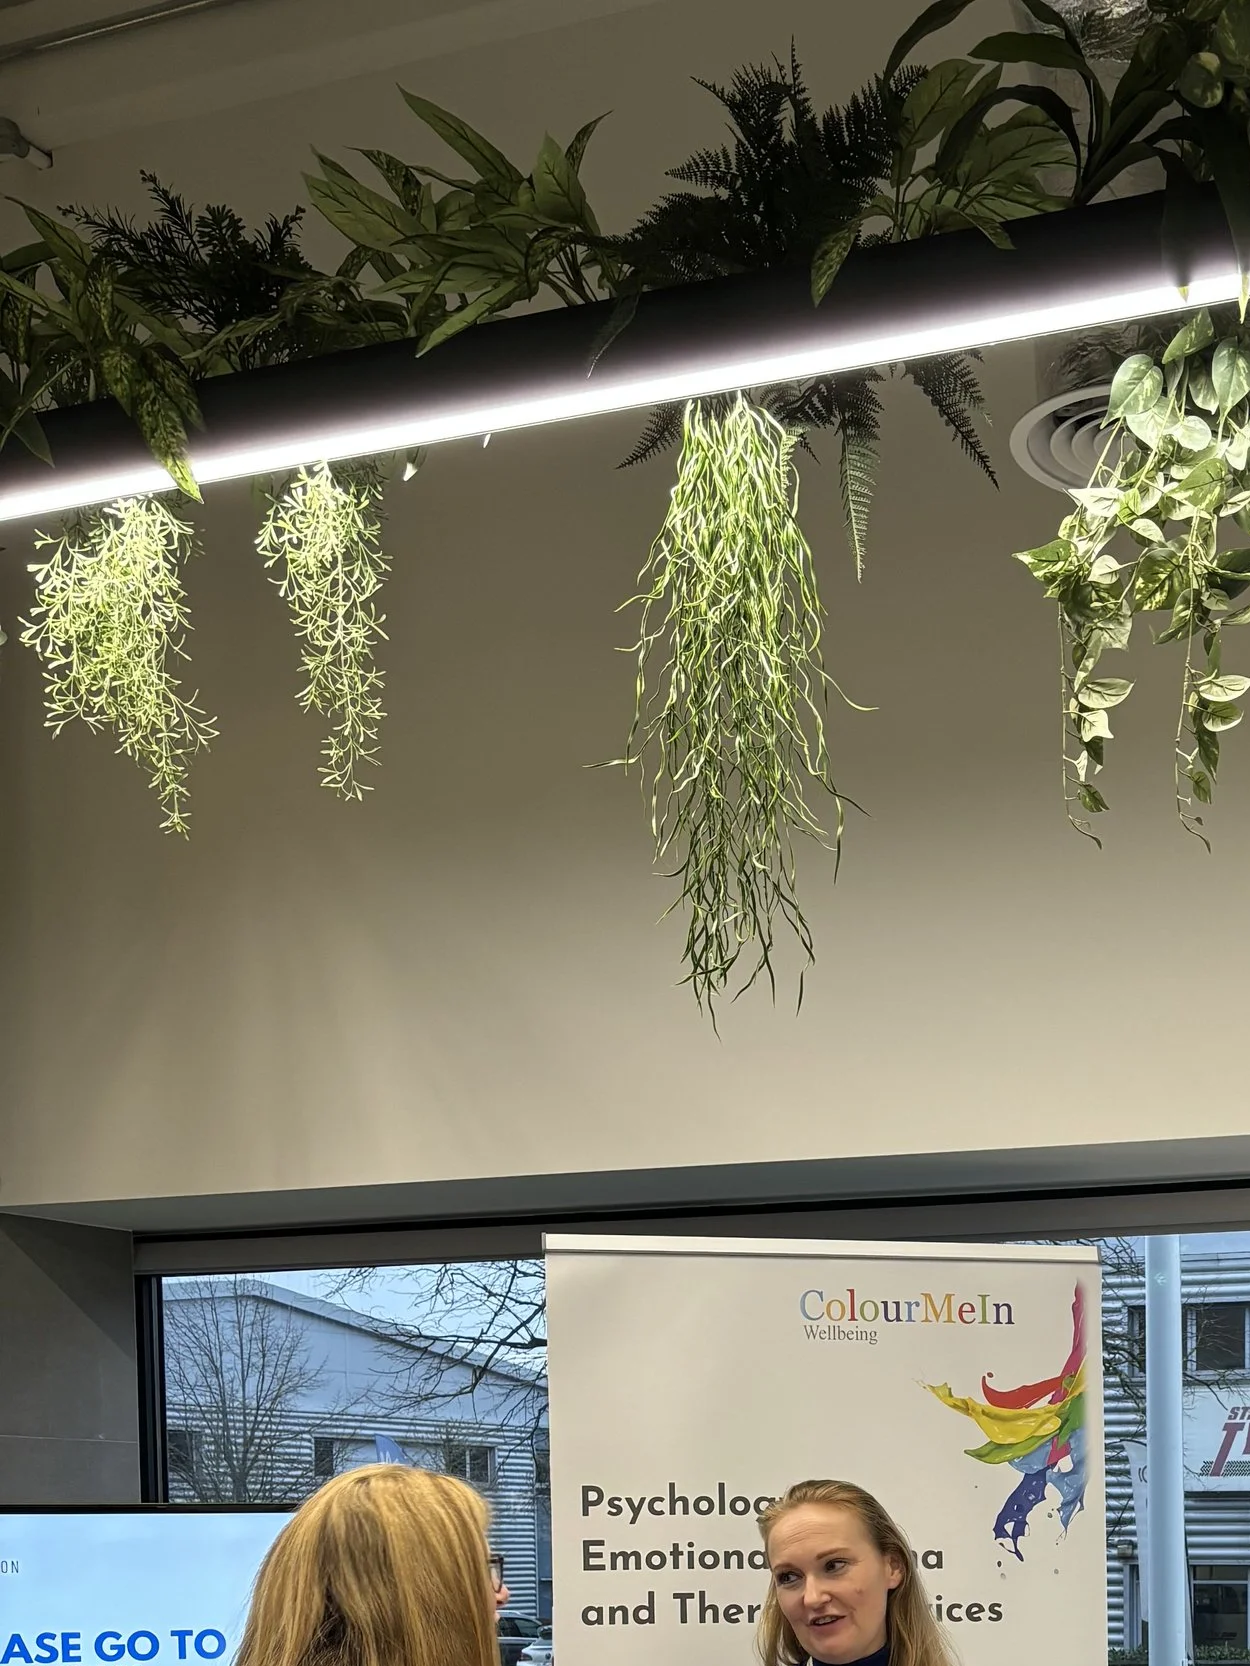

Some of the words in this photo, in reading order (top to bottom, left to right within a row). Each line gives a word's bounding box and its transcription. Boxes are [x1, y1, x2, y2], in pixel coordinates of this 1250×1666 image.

[800, 1289, 1015, 1325] ColourMeIn
[803, 1325, 878, 1345] Wellbeing
[582, 1482, 781, 1524] Psycholo
[0, 1560, 19, 1574] ON
[583, 1540, 769, 1571] Emotiona
[582, 1591, 655, 1625] and
[673, 1591, 762, 1624] Ther
[935, 1595, 1003, 1622] ices
[0, 1632, 81, 1664] ASE
[94, 1630, 159, 1661] GO
[170, 1629, 227, 1660] TO
